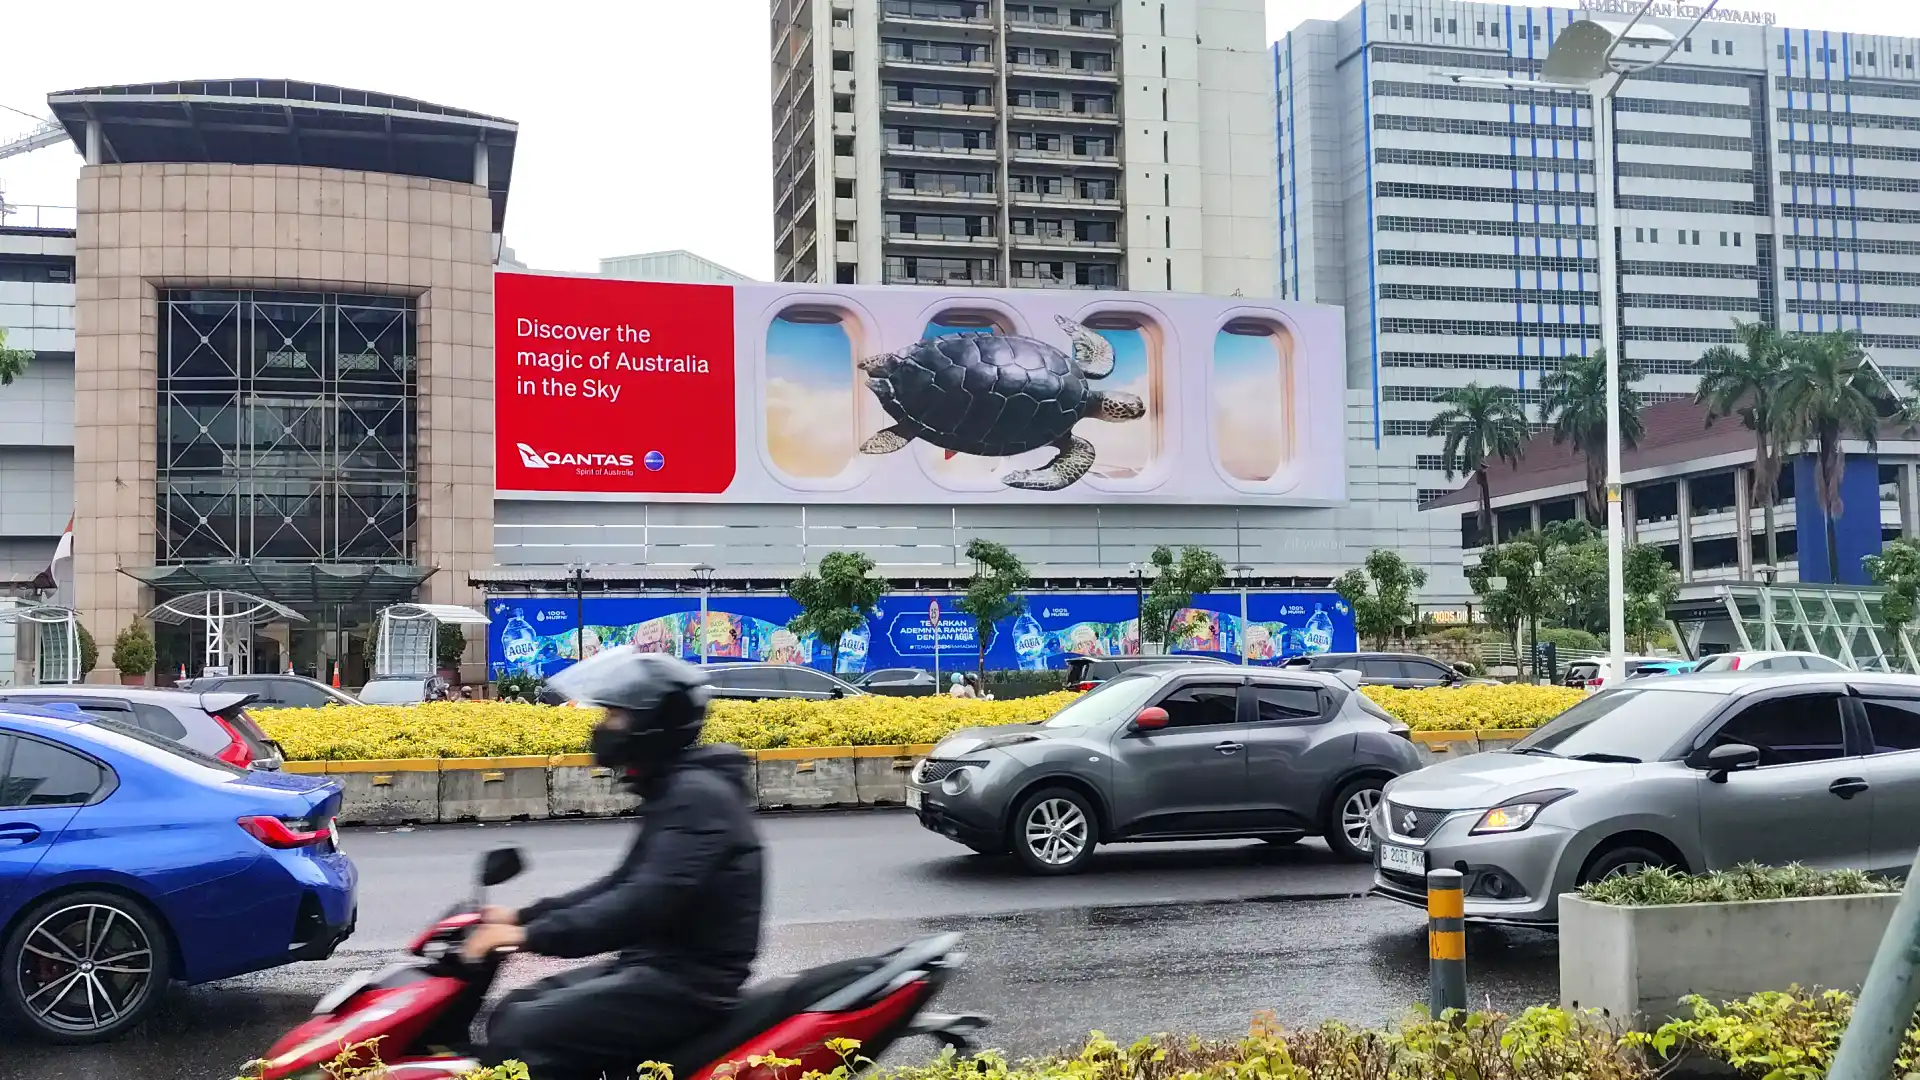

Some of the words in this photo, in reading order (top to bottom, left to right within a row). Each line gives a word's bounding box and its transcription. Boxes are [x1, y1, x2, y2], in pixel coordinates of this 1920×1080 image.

[517, 318, 611, 342] Discover
[616, 324, 651, 343] the
[517, 350, 583, 372] magic
[589, 352, 611, 370] of
[616, 352, 710, 374] Australia
[517, 376, 536, 396] in
[541, 378, 577, 397] the
[582, 379, 621, 402] Sky
[543, 451, 634, 466] QANTAS
[576, 468, 594, 477] Spirit
[604, 469, 634, 477] Australia
[1431, 610, 1455, 621] OODS
[954, 633, 974, 641] AQUA
[1018, 637, 1041, 650] AQUA
[1307, 632, 1330, 646] AQUA
[508, 642, 535, 658] AQUA
[840, 638, 865, 651] AQUA
[1383, 846, 1388, 860] B
[1391, 848, 1408, 864] 2033
